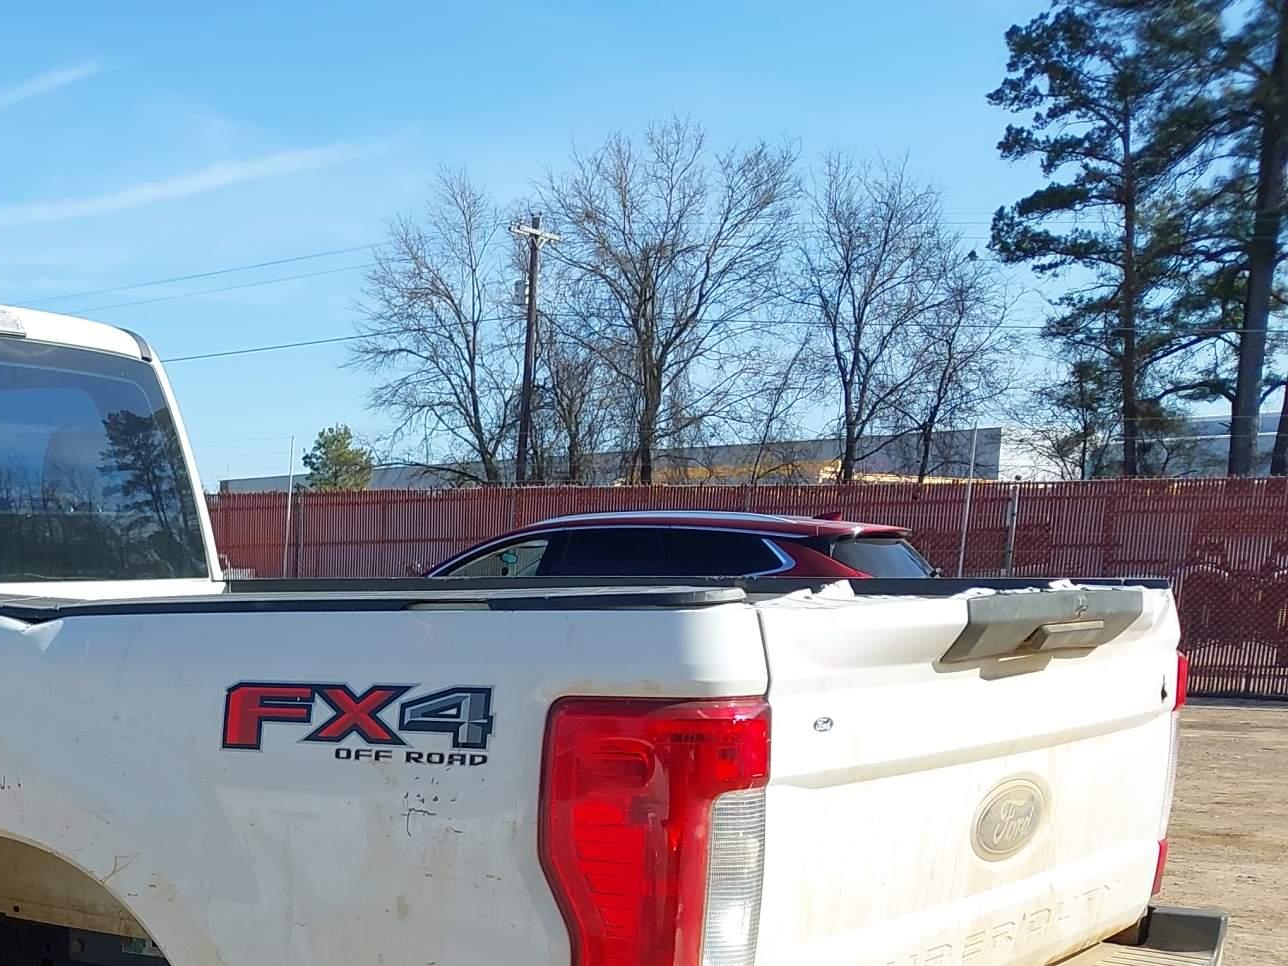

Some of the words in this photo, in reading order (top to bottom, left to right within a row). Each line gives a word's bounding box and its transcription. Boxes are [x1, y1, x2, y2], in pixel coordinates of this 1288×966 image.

[221, 680, 495, 751] FX4
[334, 748, 393, 762] OFF
[404, 751, 489, 767] ROAD
[1022, 881, 1121, 934] DT
